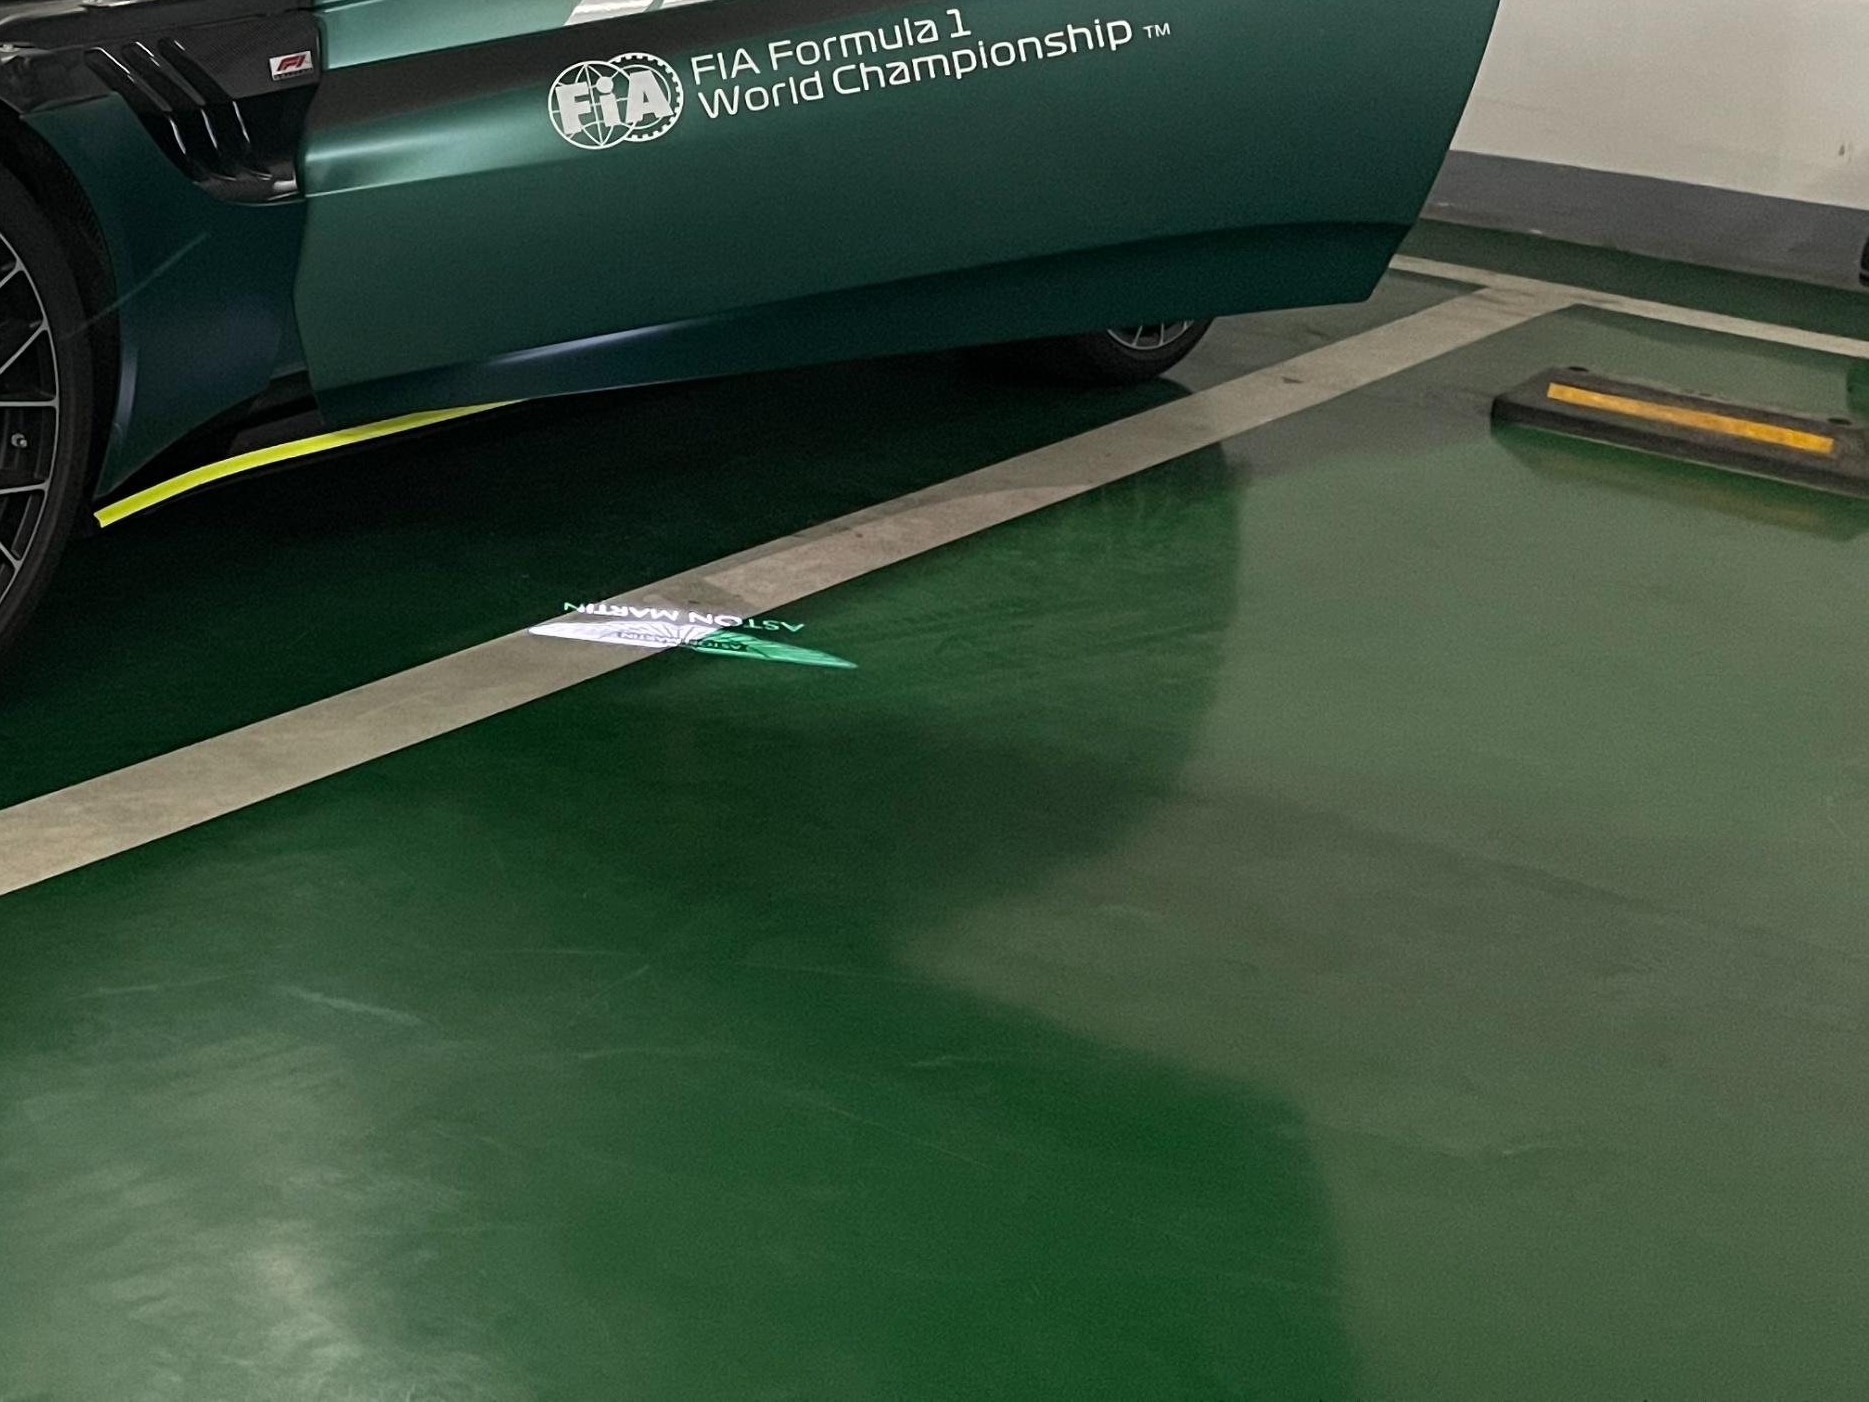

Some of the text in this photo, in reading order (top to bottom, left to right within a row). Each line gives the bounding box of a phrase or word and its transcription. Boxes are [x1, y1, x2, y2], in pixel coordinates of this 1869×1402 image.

[691, 9, 972, 85] FIA Formula 1
[697, 70, 825, 119] World
[832, 19, 1133, 96] Championship
[564, 601, 805, 633] ASTON MARTIN
